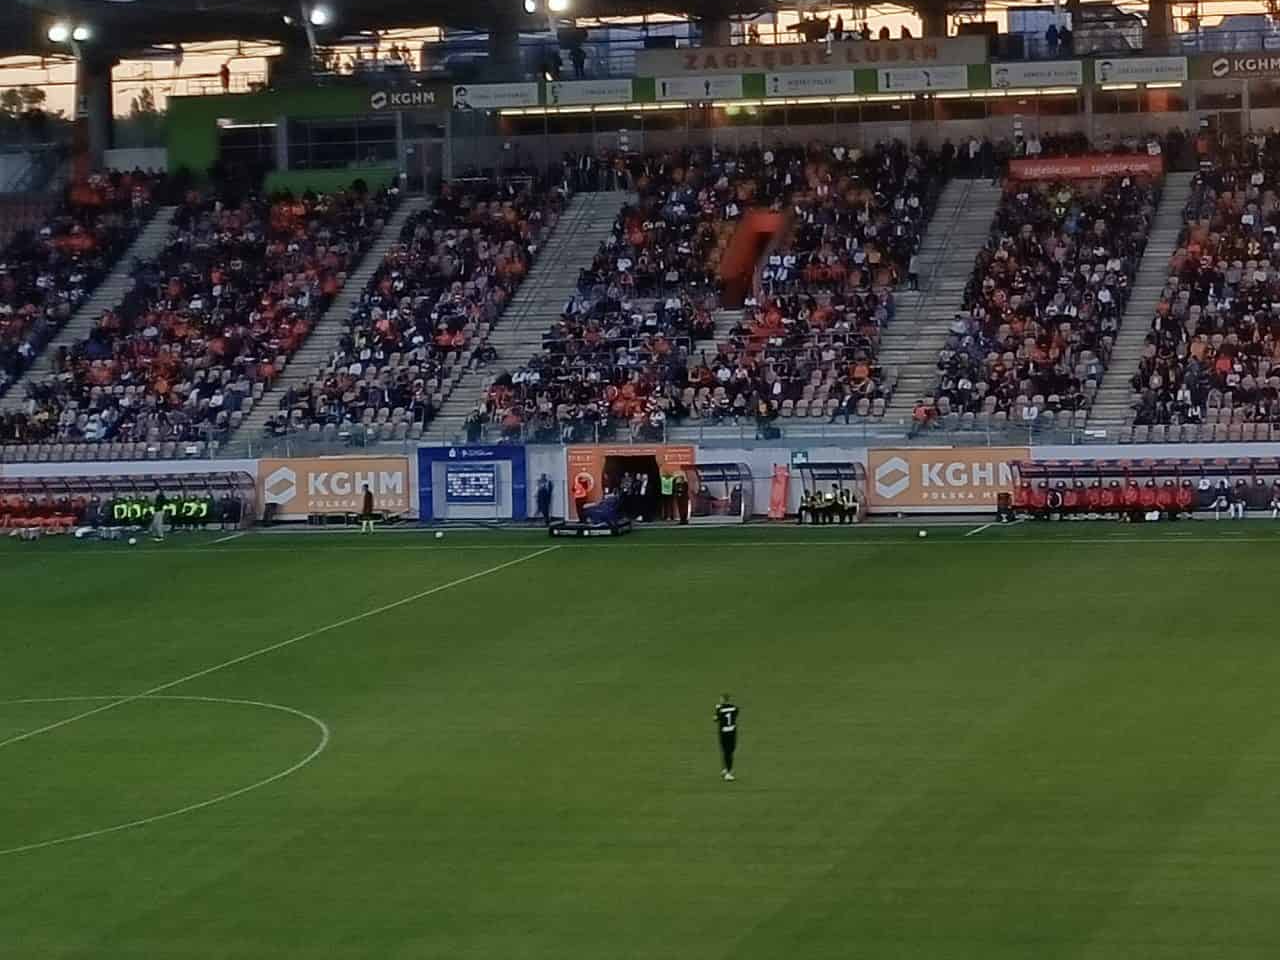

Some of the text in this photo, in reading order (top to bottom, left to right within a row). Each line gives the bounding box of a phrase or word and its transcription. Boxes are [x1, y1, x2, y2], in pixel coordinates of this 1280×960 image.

[390, 90, 436, 106] KGHM
[307, 471, 403, 496] KGHM
[921, 462, 1021, 486] KGHM
[724, 712, 732, 726] 1
